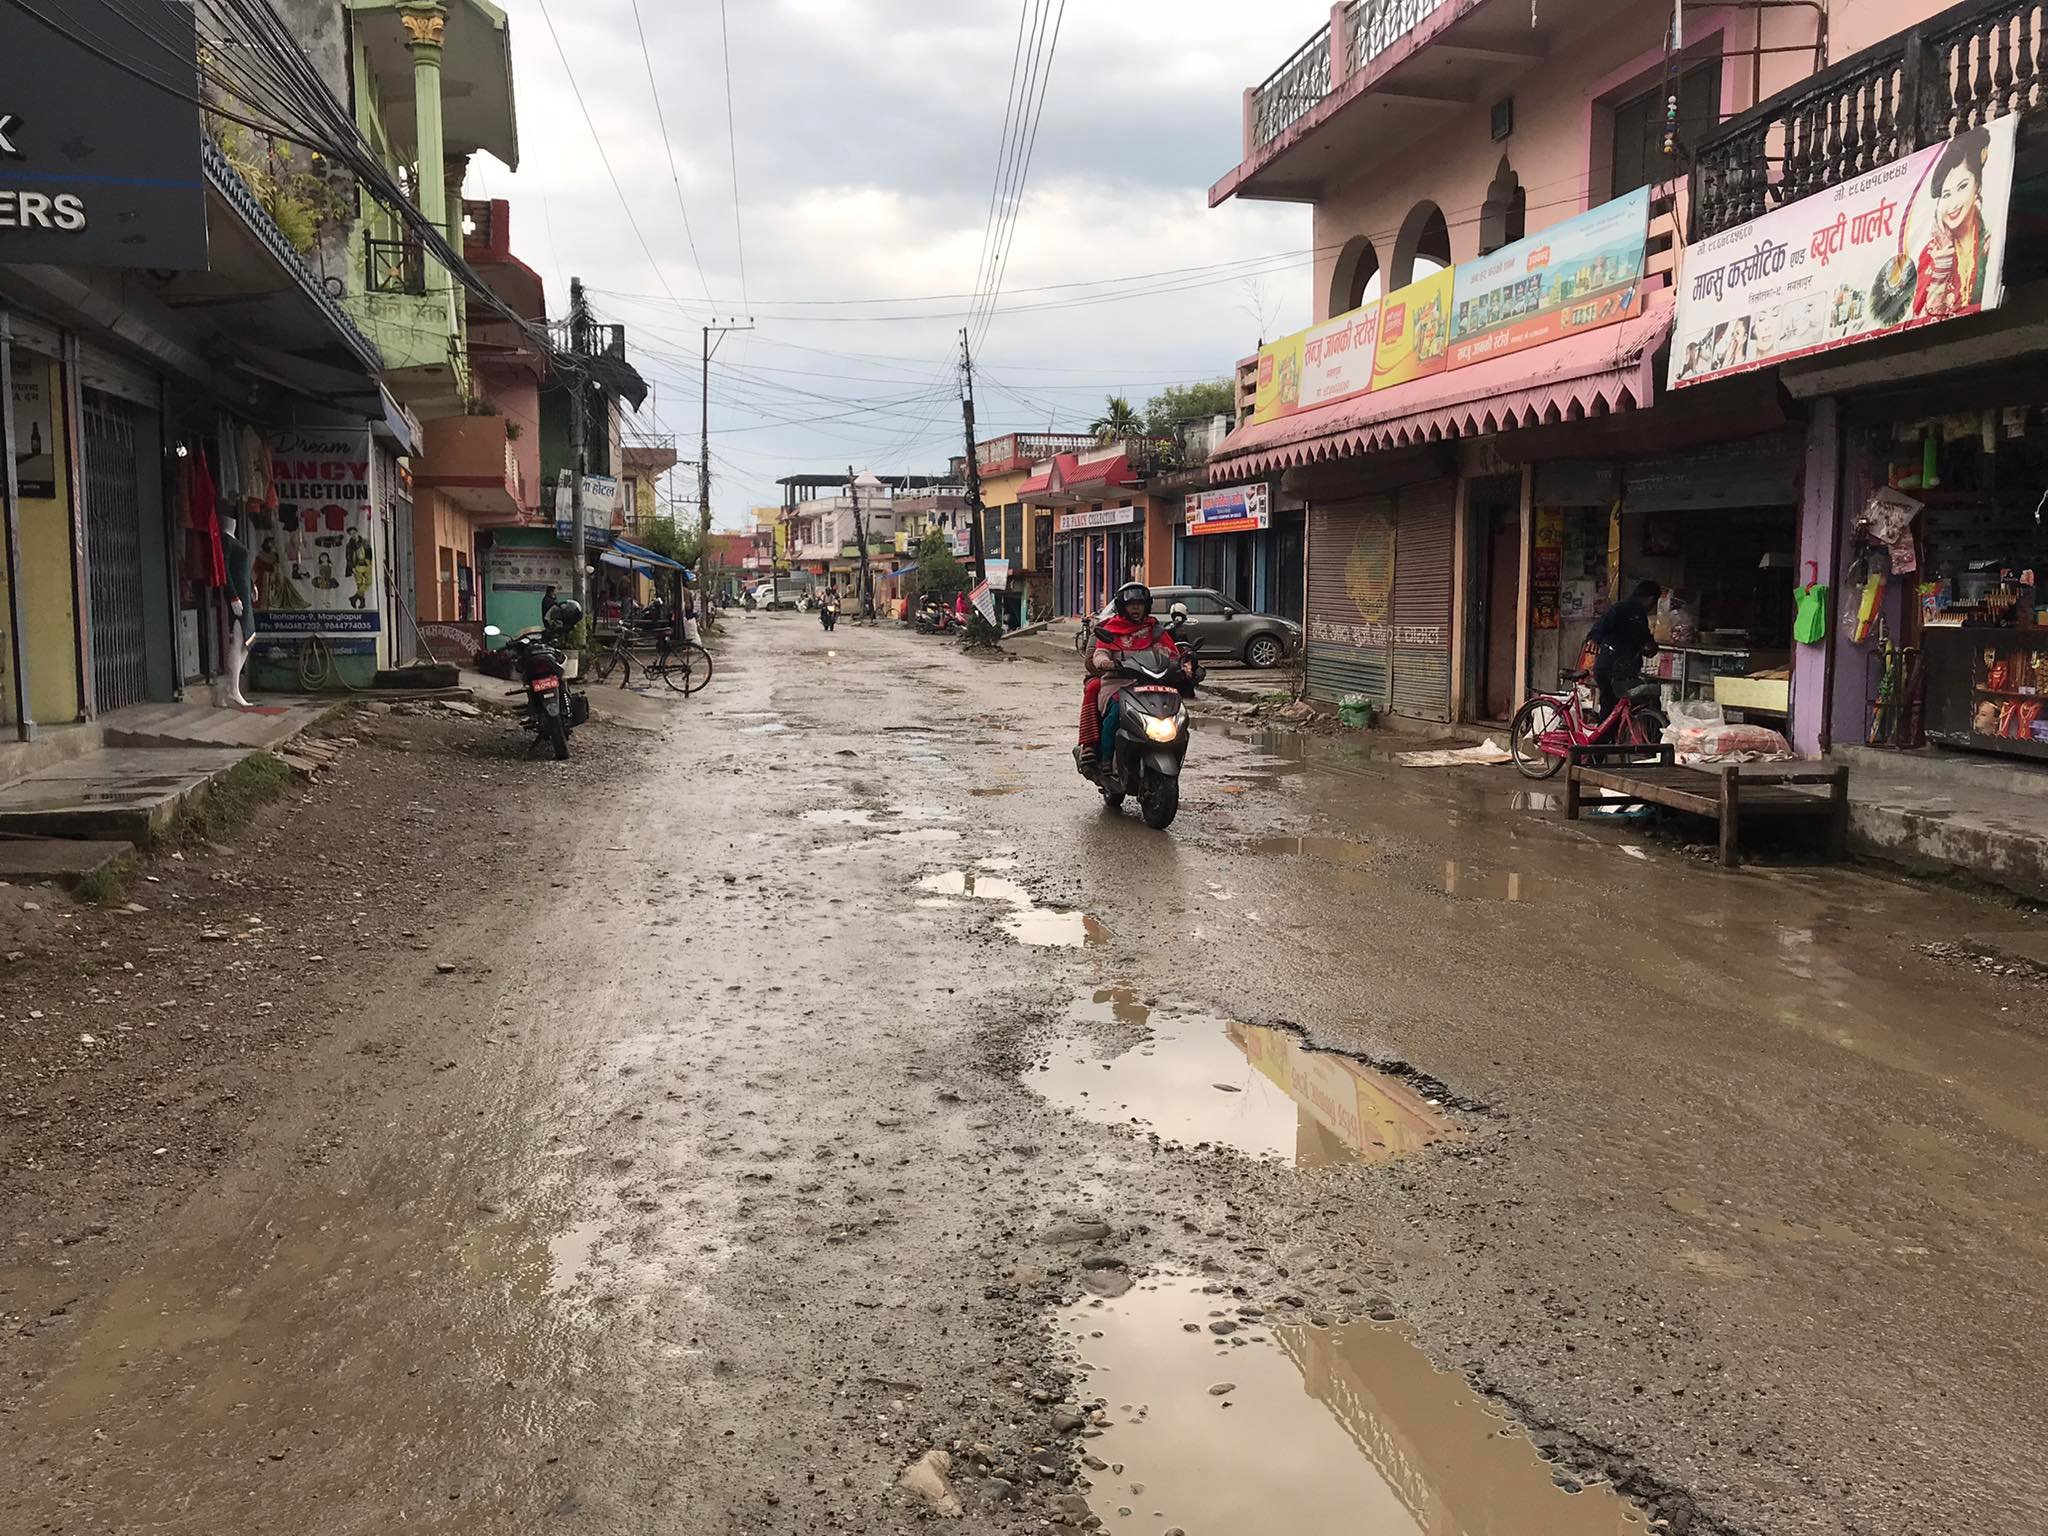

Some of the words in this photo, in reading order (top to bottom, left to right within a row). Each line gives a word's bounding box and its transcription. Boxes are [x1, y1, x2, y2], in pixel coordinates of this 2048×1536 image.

[1692, 266, 1726, 302] मान्सु
[1727, 239, 1788, 289] कस्मेटिक
[1789, 248, 1807, 268] एण्ड
[1810, 212, 1848, 267] ब्यूटी
[1850, 197, 1898, 246] पार्लर
[1323, 320, 1354, 360] जानकी
[272, 431, 352, 454] Dream
[272, 460, 369, 481] ANCY
